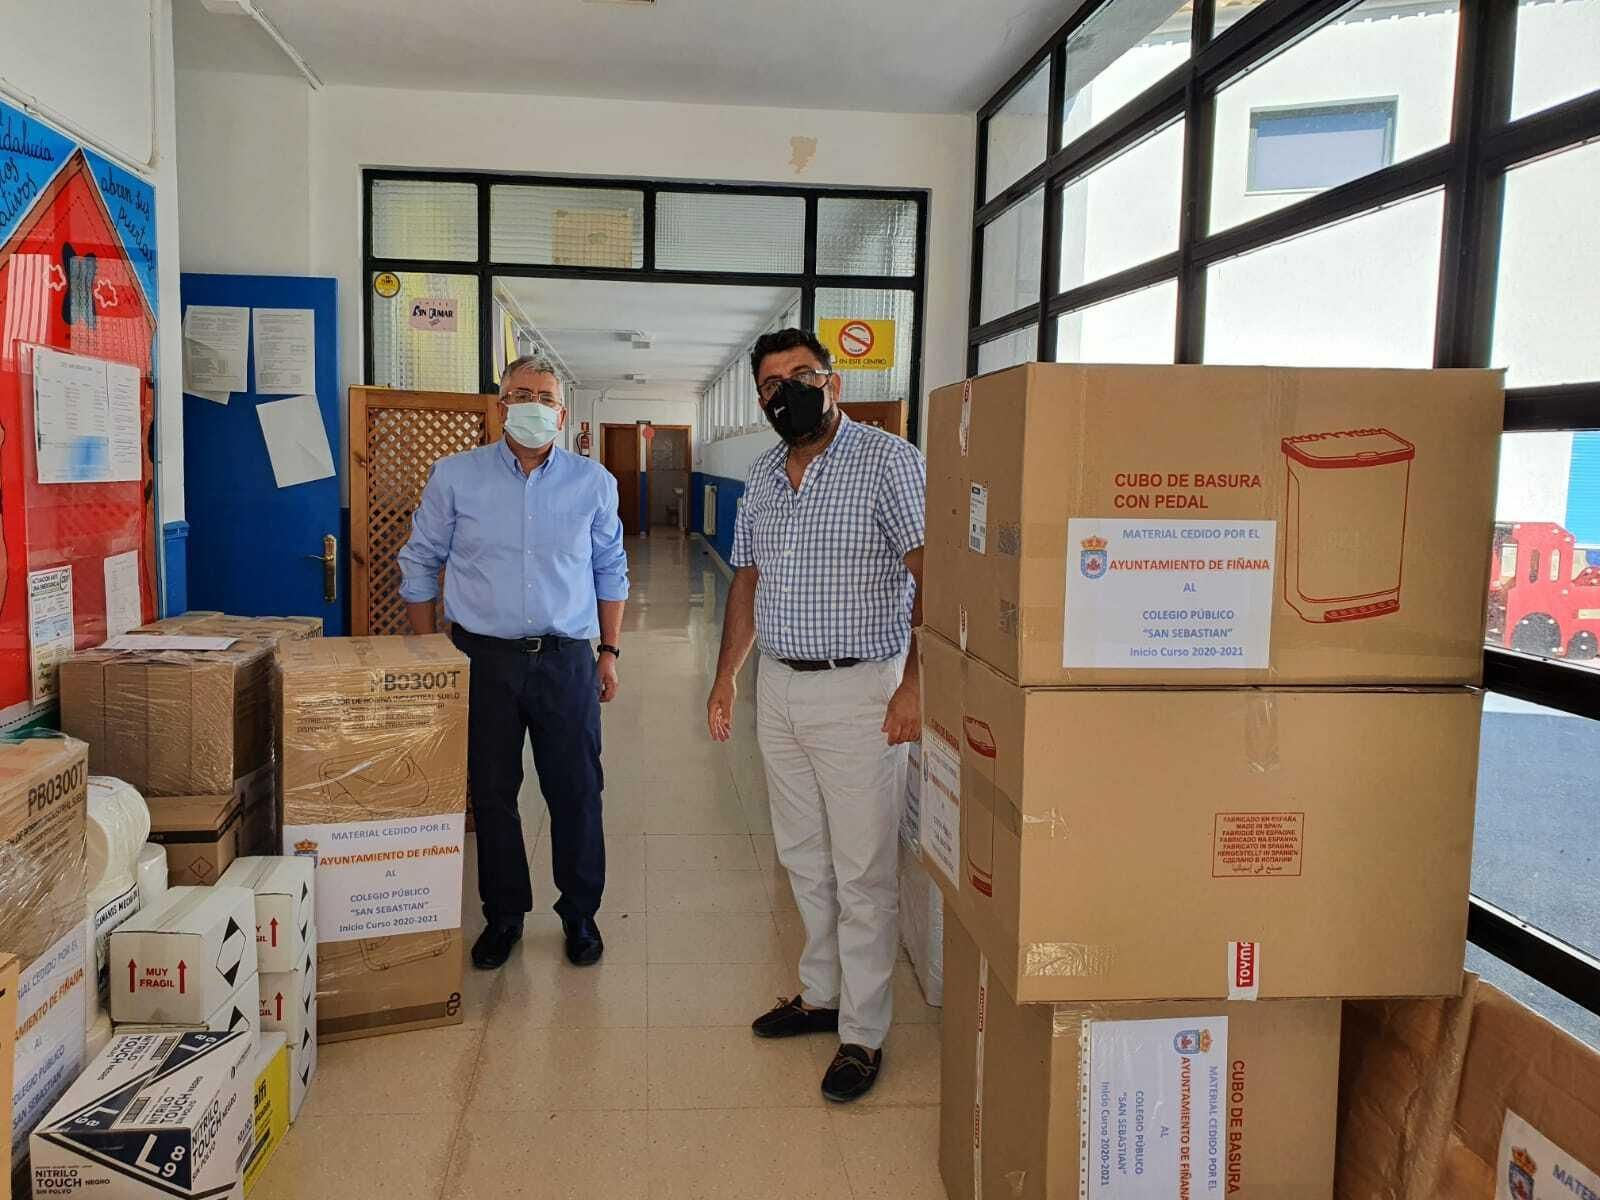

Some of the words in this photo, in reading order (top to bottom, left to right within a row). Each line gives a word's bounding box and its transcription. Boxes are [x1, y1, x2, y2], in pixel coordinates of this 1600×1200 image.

[1115, 473, 1163, 487] CUBO
[1167, 473, 1190, 487] DE
[1194, 474, 1262, 488] BASURA
[1114, 494, 1150, 508] CON
[1155, 494, 1209, 509] PEDAL
[1122, 529, 1178, 539] MATERIAL
[1180, 529, 1221, 539] CEDIDO
[1224, 529, 1246, 539] POR
[1248, 529, 1260, 539] EL
[1110, 559, 1206, 570] AYUNTAMIENTO
[1208, 559, 1224, 570] DE
[1226, 557, 1270, 570] FIÑANA
[1183, 583, 1197, 593] AL
[1142, 610, 1188, 620] COLEGIO
[1190, 608, 1234, 620] PÚBLICO
[1130, 647, 1158, 657] Inicio
[1160, 647, 1189, 657] Curso
[1191, 646, 1244, 657] 2020-2021
[28, 758, 86, 817] PB0300T
[331, 830, 380, 841] MATERIAL
[382, 826, 418, 836] CEDIDO
[420, 824, 439, 833] POR
[441, 823, 451, 831] EL
[319, 850, 404, 866] AYUNTAMIENTO
[407, 849, 420, 858] DE
[422, 845, 460, 857] FIÑANA
[385, 870, 397, 878] AL
[350, 892, 390, 903] COLEGIO
[391, 887, 430, 898] PÚBLICO
[339, 923, 364, 932] Inicio
[366, 921, 391, 930] Curso
[393, 914, 438, 926] 2020-2021
[146, 967, 169, 977] MUY
[139, 979, 175, 988] FRAGIL
[1208, 1065, 1218, 1116] MATERIAL
[1231, 1060, 1245, 1103] CUBO
[1100, 1081, 1110, 1107] Inicio
[1180, 1056, 1191, 1144] AYUNTAMIENTO
[160, 1092, 188, 1124] TOUCH
[1135, 1090, 1145, 1132] COLEGIO
[1230, 1107, 1243, 1128] DE
[192, 1100, 219, 1149] NITRILO
[1101, 1109, 1110, 1136] Curso
[1160, 1125, 1170, 1138] AL
[192, 1111, 222, 1167] TOUCH
[1208, 1118, 1218, 1155] CEDIDO
[135, 1133, 161, 1174] L
[1100, 1138, 1110, 1186] 2020-2021
[1135, 1134, 1146, 1175] PÚBLICO
[1180, 1146, 1190, 1161] DE
[1227, 1132, 1242, 1194] BASURA
[35, 1169, 78, 1178] NITRILO
[1208, 1157, 1217, 1178] POR
[36, 1178, 82, 1188] TOUCH
[85, 1178, 111, 1186] NEGRO
[1207, 1180, 1217, 1191] EL
